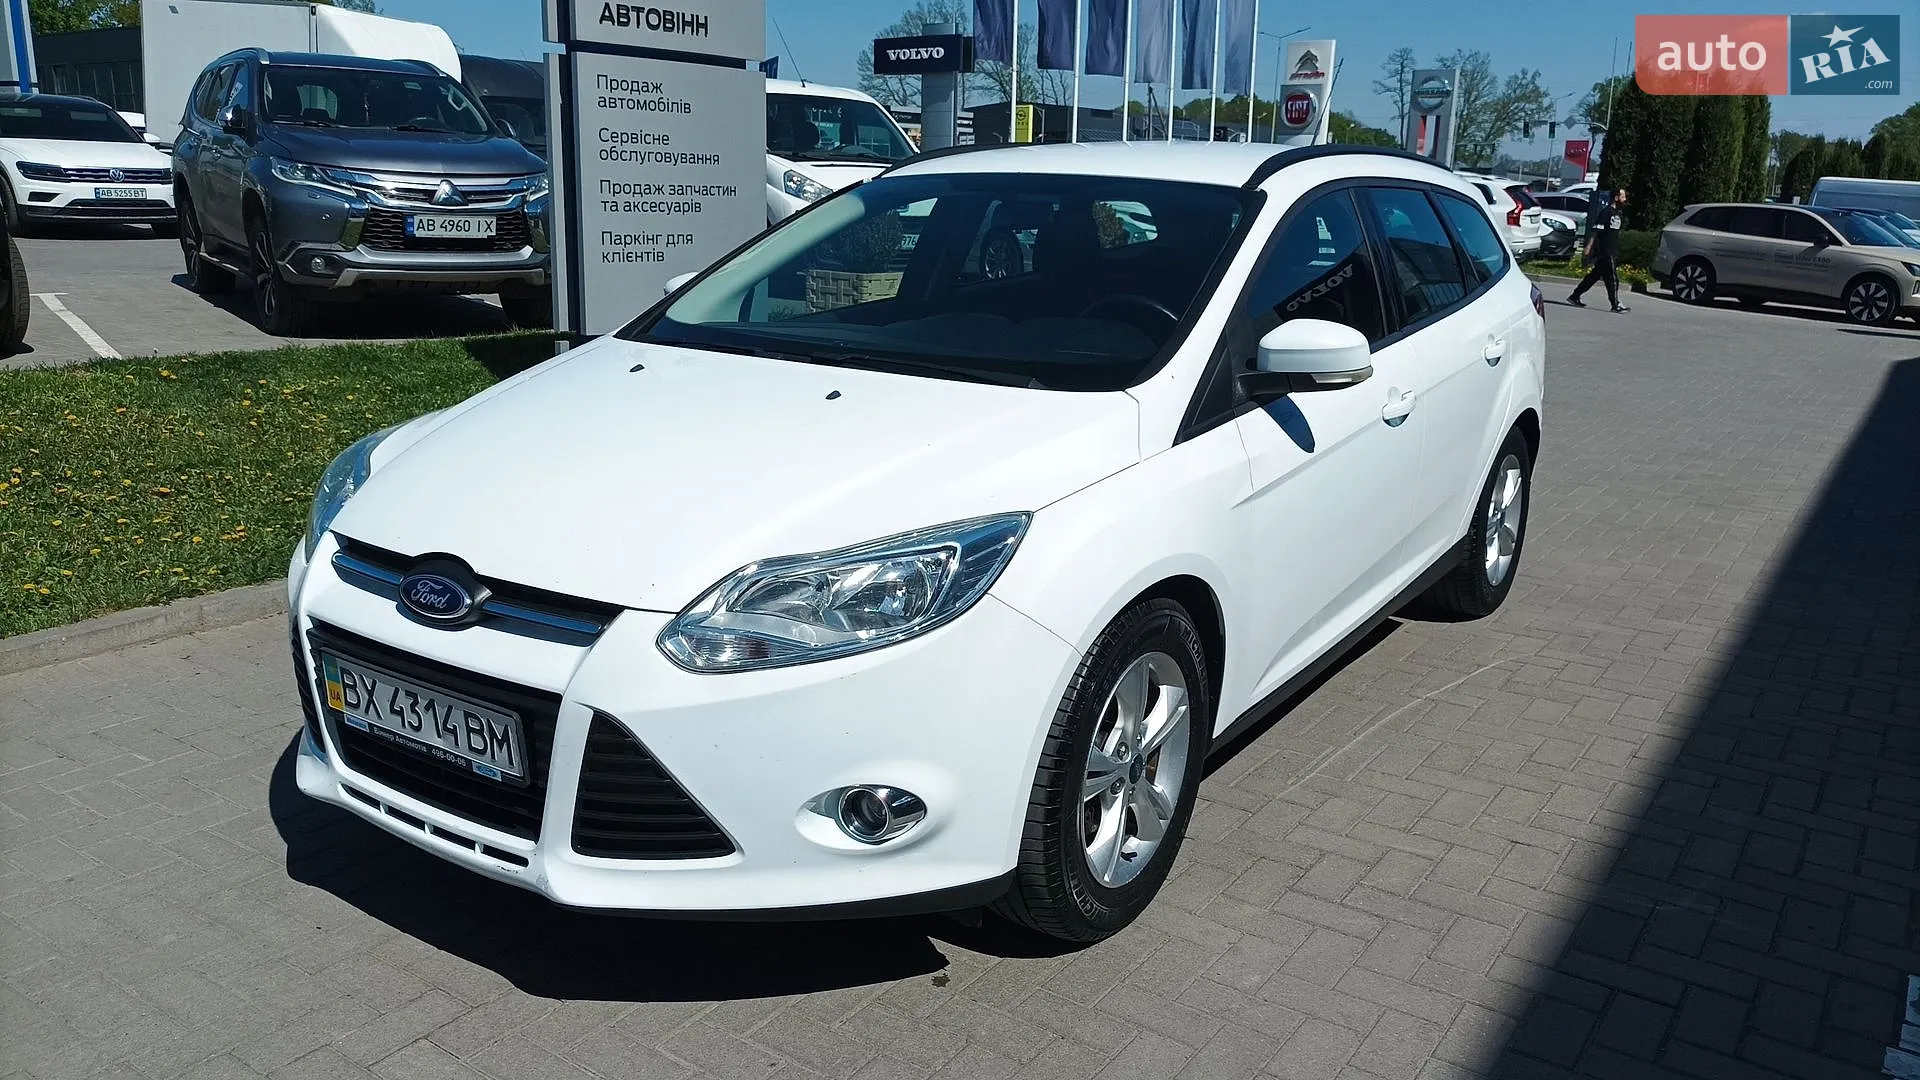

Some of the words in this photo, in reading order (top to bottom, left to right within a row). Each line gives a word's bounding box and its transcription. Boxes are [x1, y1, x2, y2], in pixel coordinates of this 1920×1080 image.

[599, 2, 708, 37] АВТОВІНН
[886, 47, 945, 60] VOLVO
[597, 74, 663, 95] Продаж
[597, 96, 691, 114] автомобілів
[598, 127, 670, 146] Сервісне
[599, 146, 720, 166] обслуговування
[600, 180, 666, 198] Продаж
[668, 185, 737, 197] запчастин
[601, 200, 619, 213] та
[623, 199, 702, 215] аксесуарів
[416, 218, 436, 231] AB
[440, 219, 471, 232] 4960
[601, 231, 662, 248] Паркінг
[666, 234, 693, 247] для
[602, 249, 665, 263] клієнтів
[411, 579, 451, 609] Ford
[330, 690, 342, 703] UA
